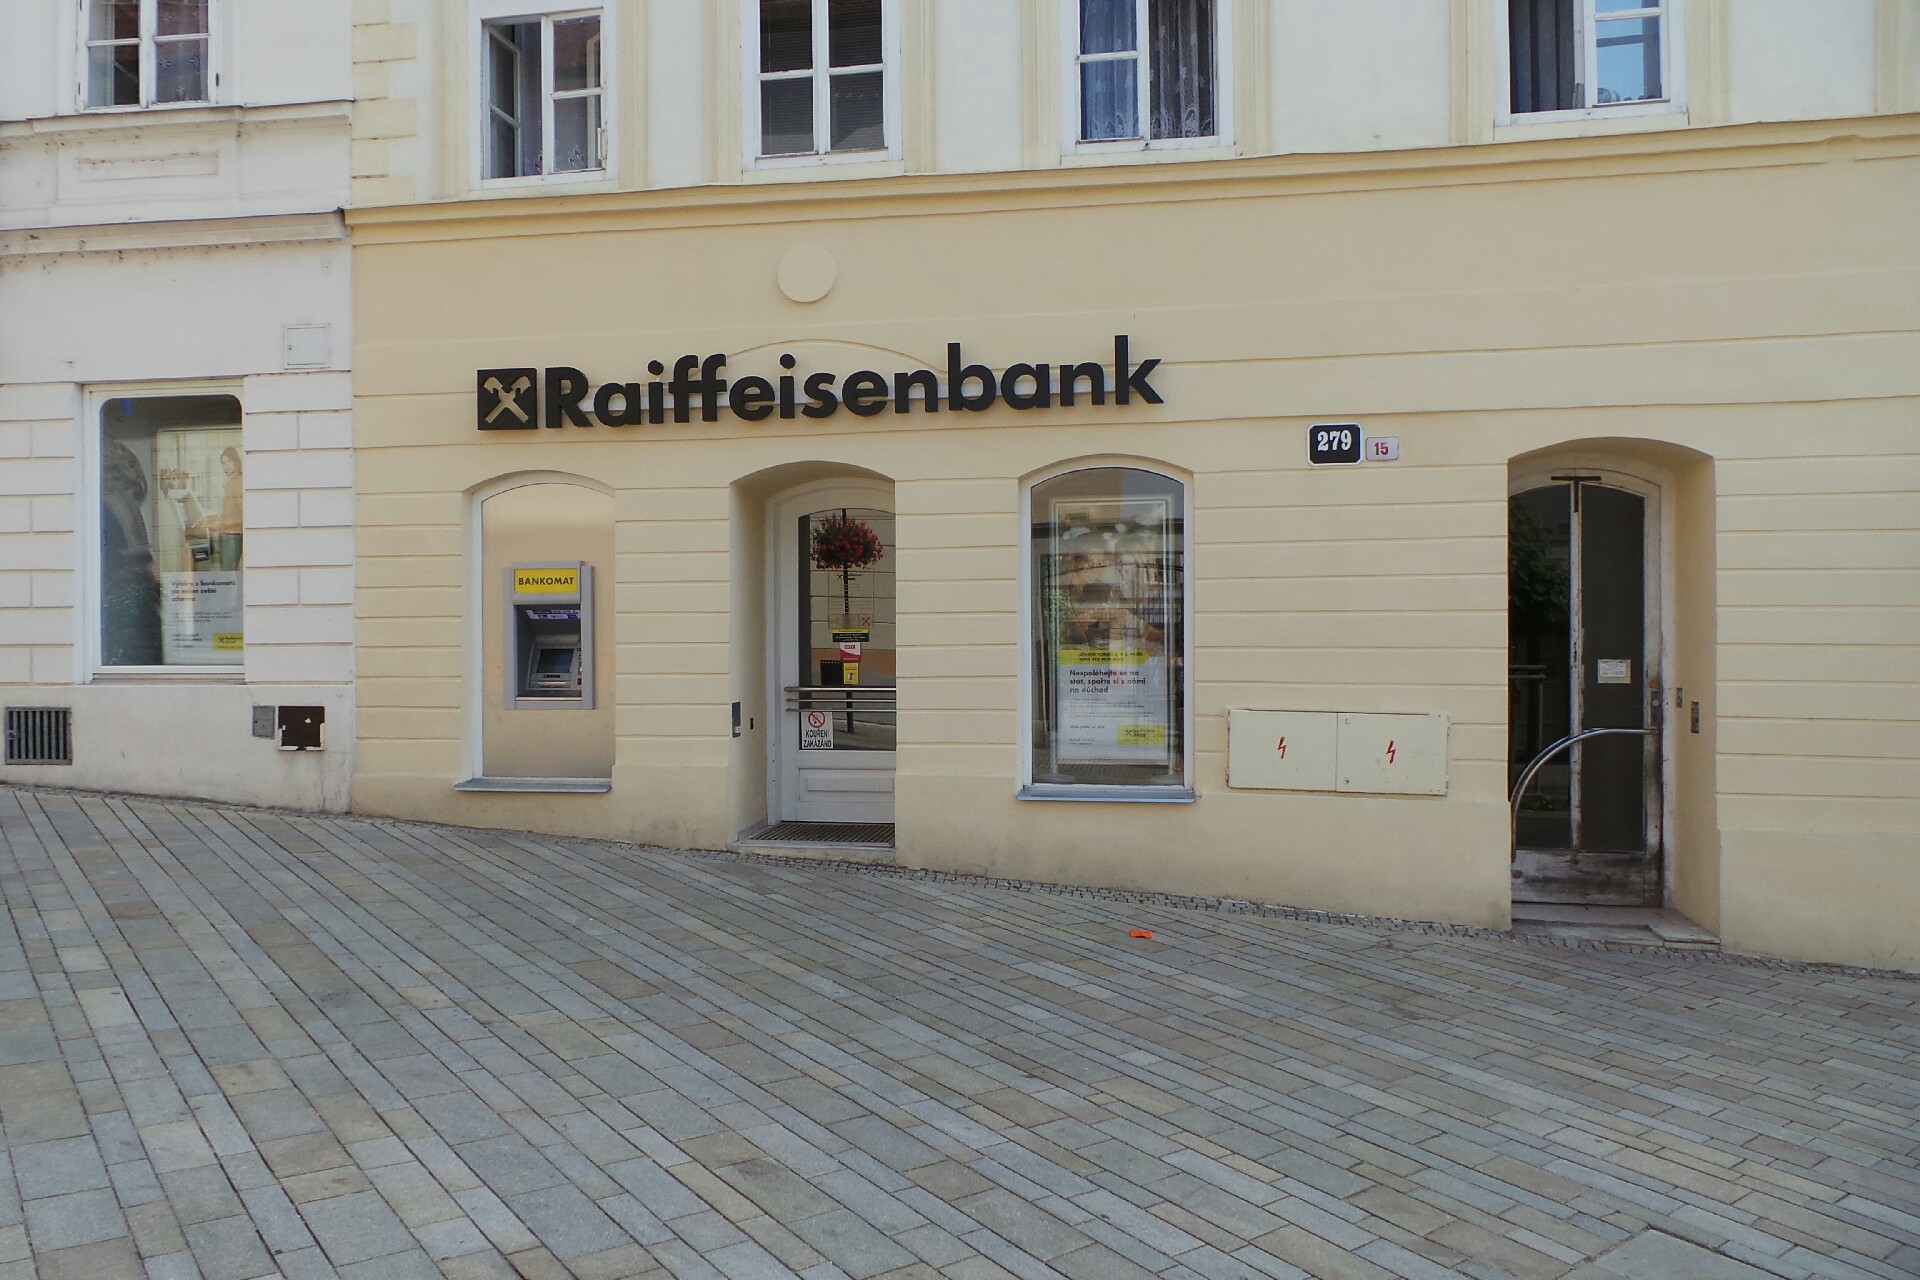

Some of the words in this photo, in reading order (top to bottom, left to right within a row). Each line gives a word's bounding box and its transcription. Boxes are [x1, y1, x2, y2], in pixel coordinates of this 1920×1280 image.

[545, 335, 1164, 428] Raiffeisenbank
[1317, 430, 1352, 452] 279
[1375, 442, 1389, 456] 15
[518, 577, 574, 586] BANKOMAT
[1069, 669, 1117, 678] Nespoléhejte
[1069, 678, 1086, 686] stát,
[1087, 677, 1111, 687] spořte
[1127, 677, 1146, 685] námi
